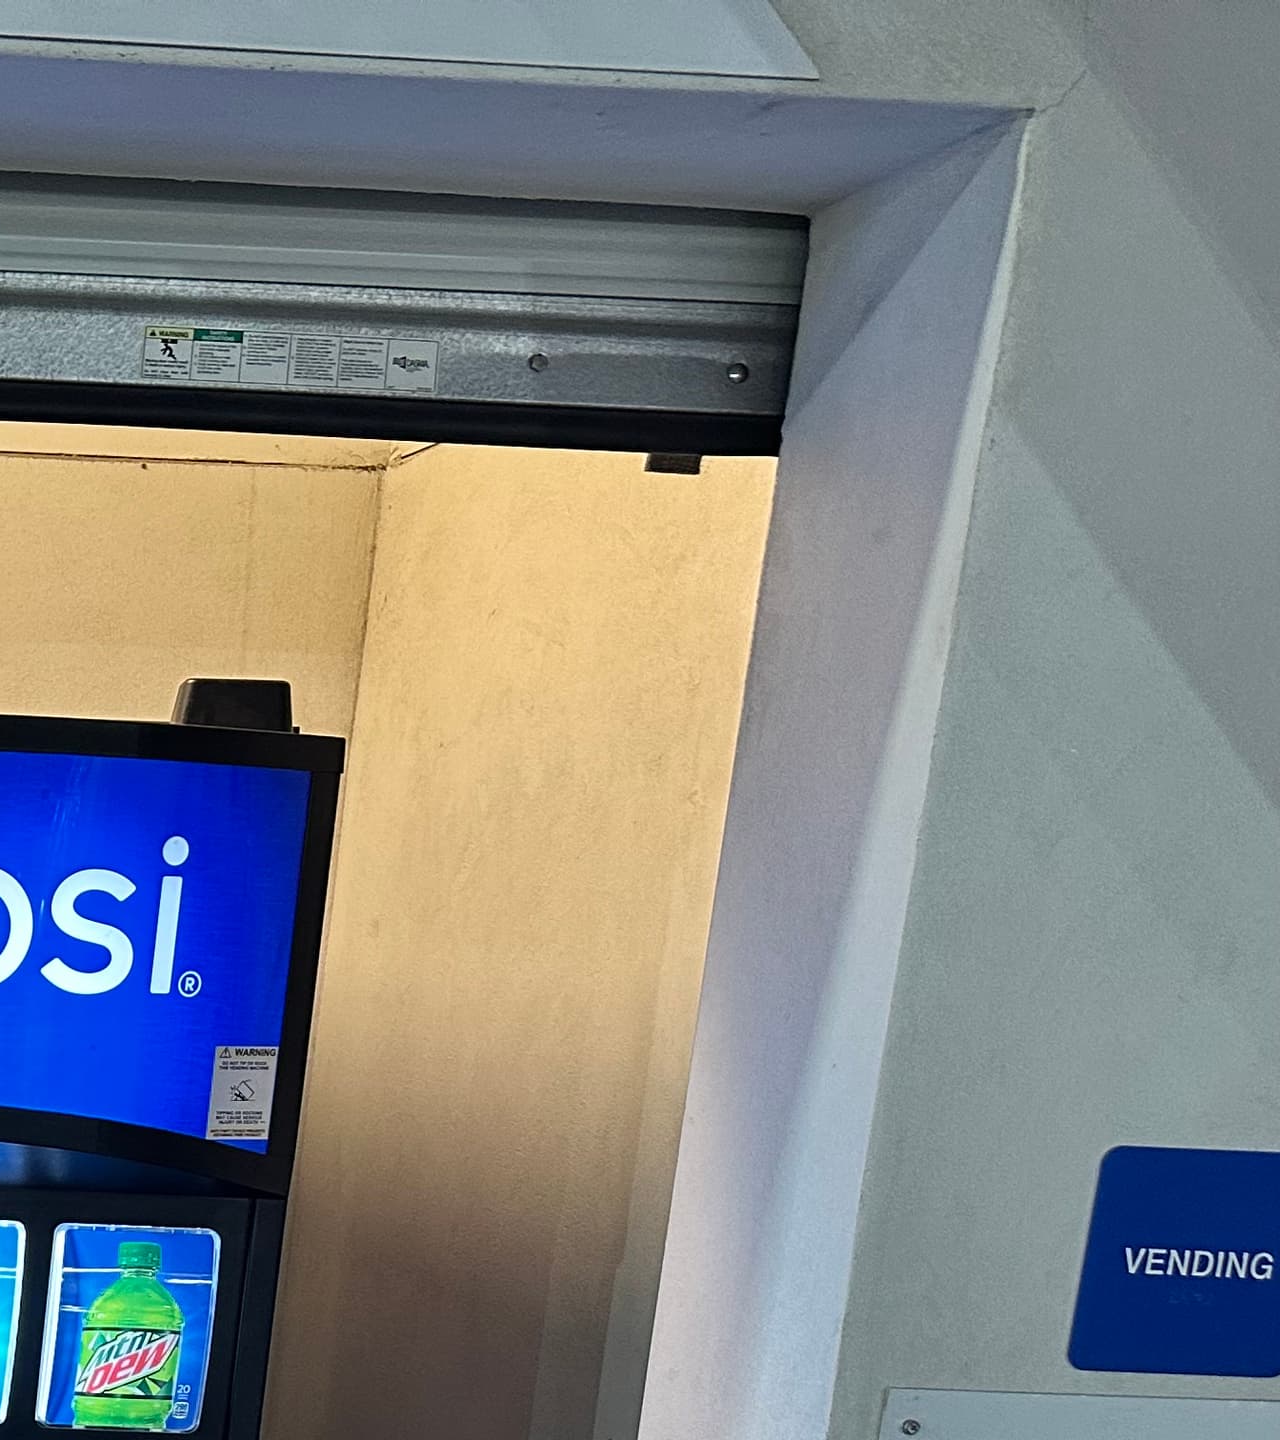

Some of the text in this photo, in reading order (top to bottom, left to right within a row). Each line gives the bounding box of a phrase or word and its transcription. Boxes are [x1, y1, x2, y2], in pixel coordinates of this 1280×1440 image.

[234, 1048, 277, 1057] WARNING
[1122, 1247, 1275, 1281] VENDING
[176, 1384, 191, 1395] 20
